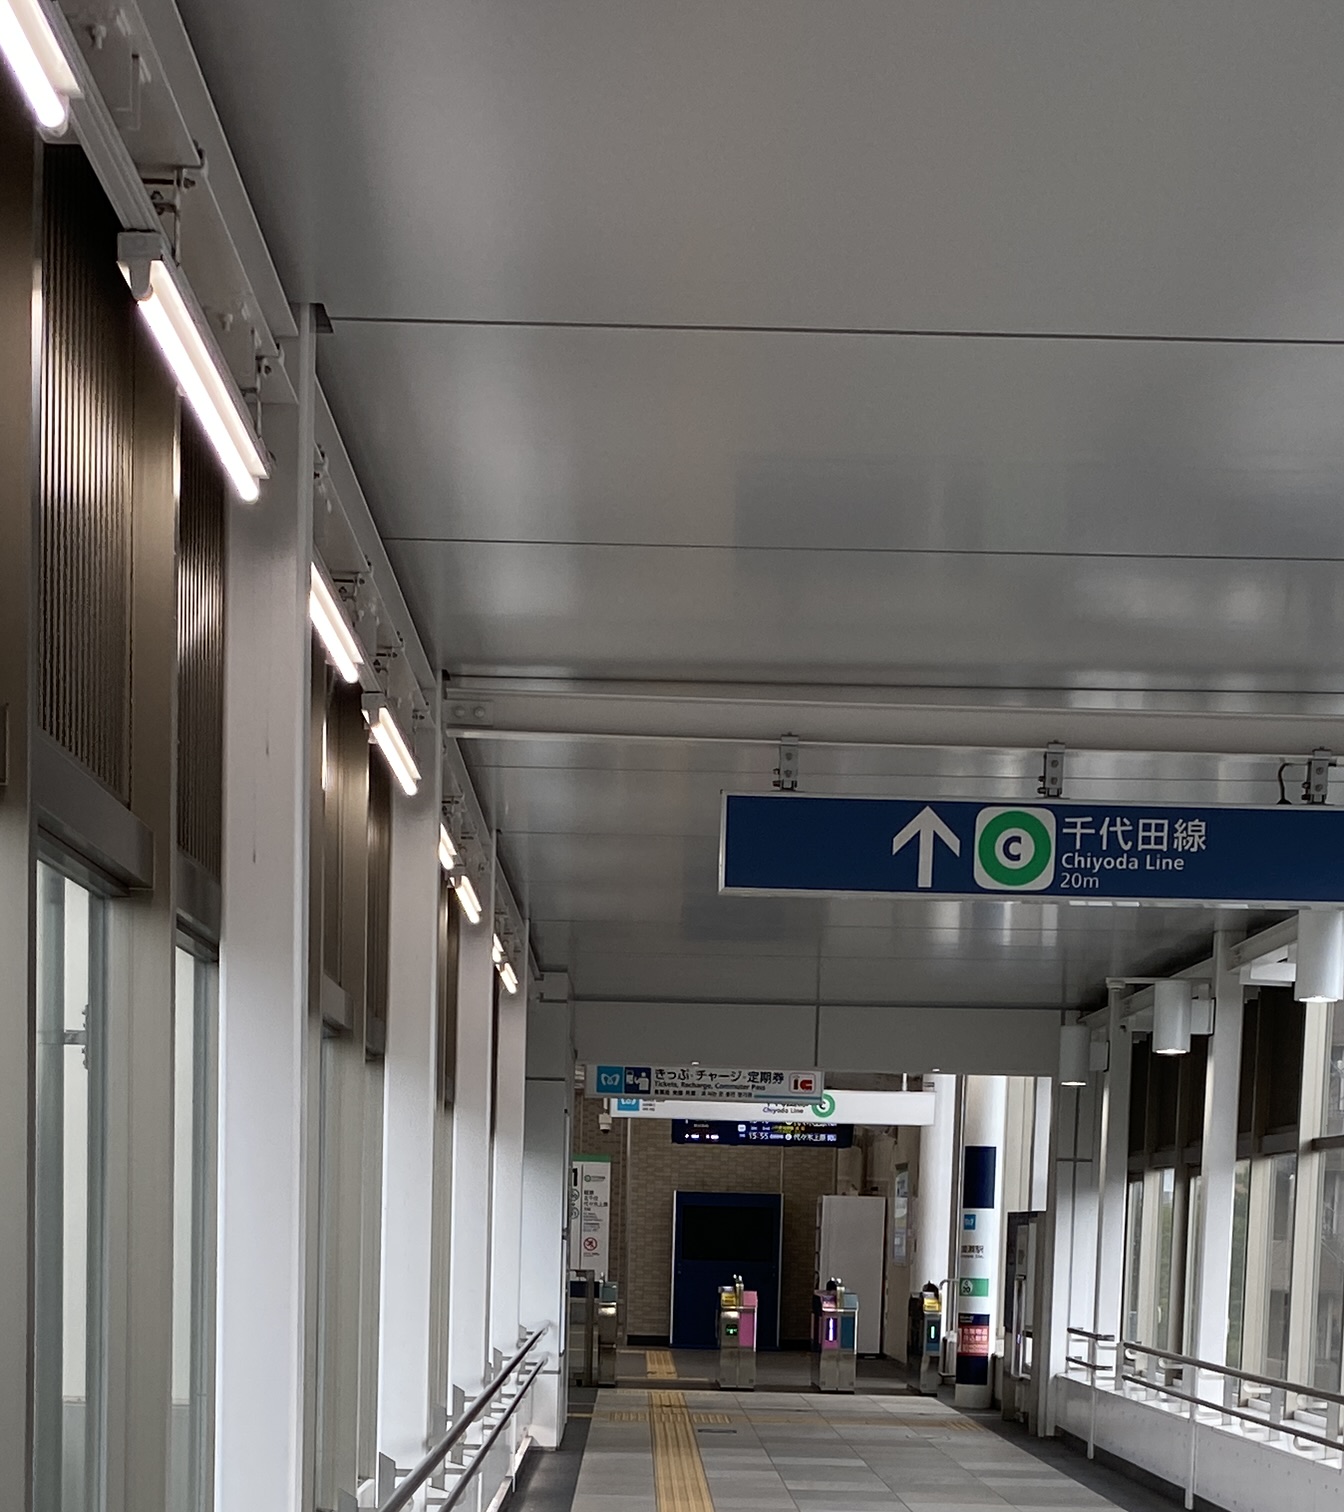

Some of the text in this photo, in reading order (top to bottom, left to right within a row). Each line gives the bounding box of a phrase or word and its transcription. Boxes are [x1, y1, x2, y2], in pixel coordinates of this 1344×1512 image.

[1061, 816, 1208, 853] 千代田線
[1002, 835, 1022, 862] C
[1061, 852, 1185, 873] Chiyoda Line
[1060, 873, 1100, 889] 20m
[763, 1107, 789, 1115] Chiyoda
